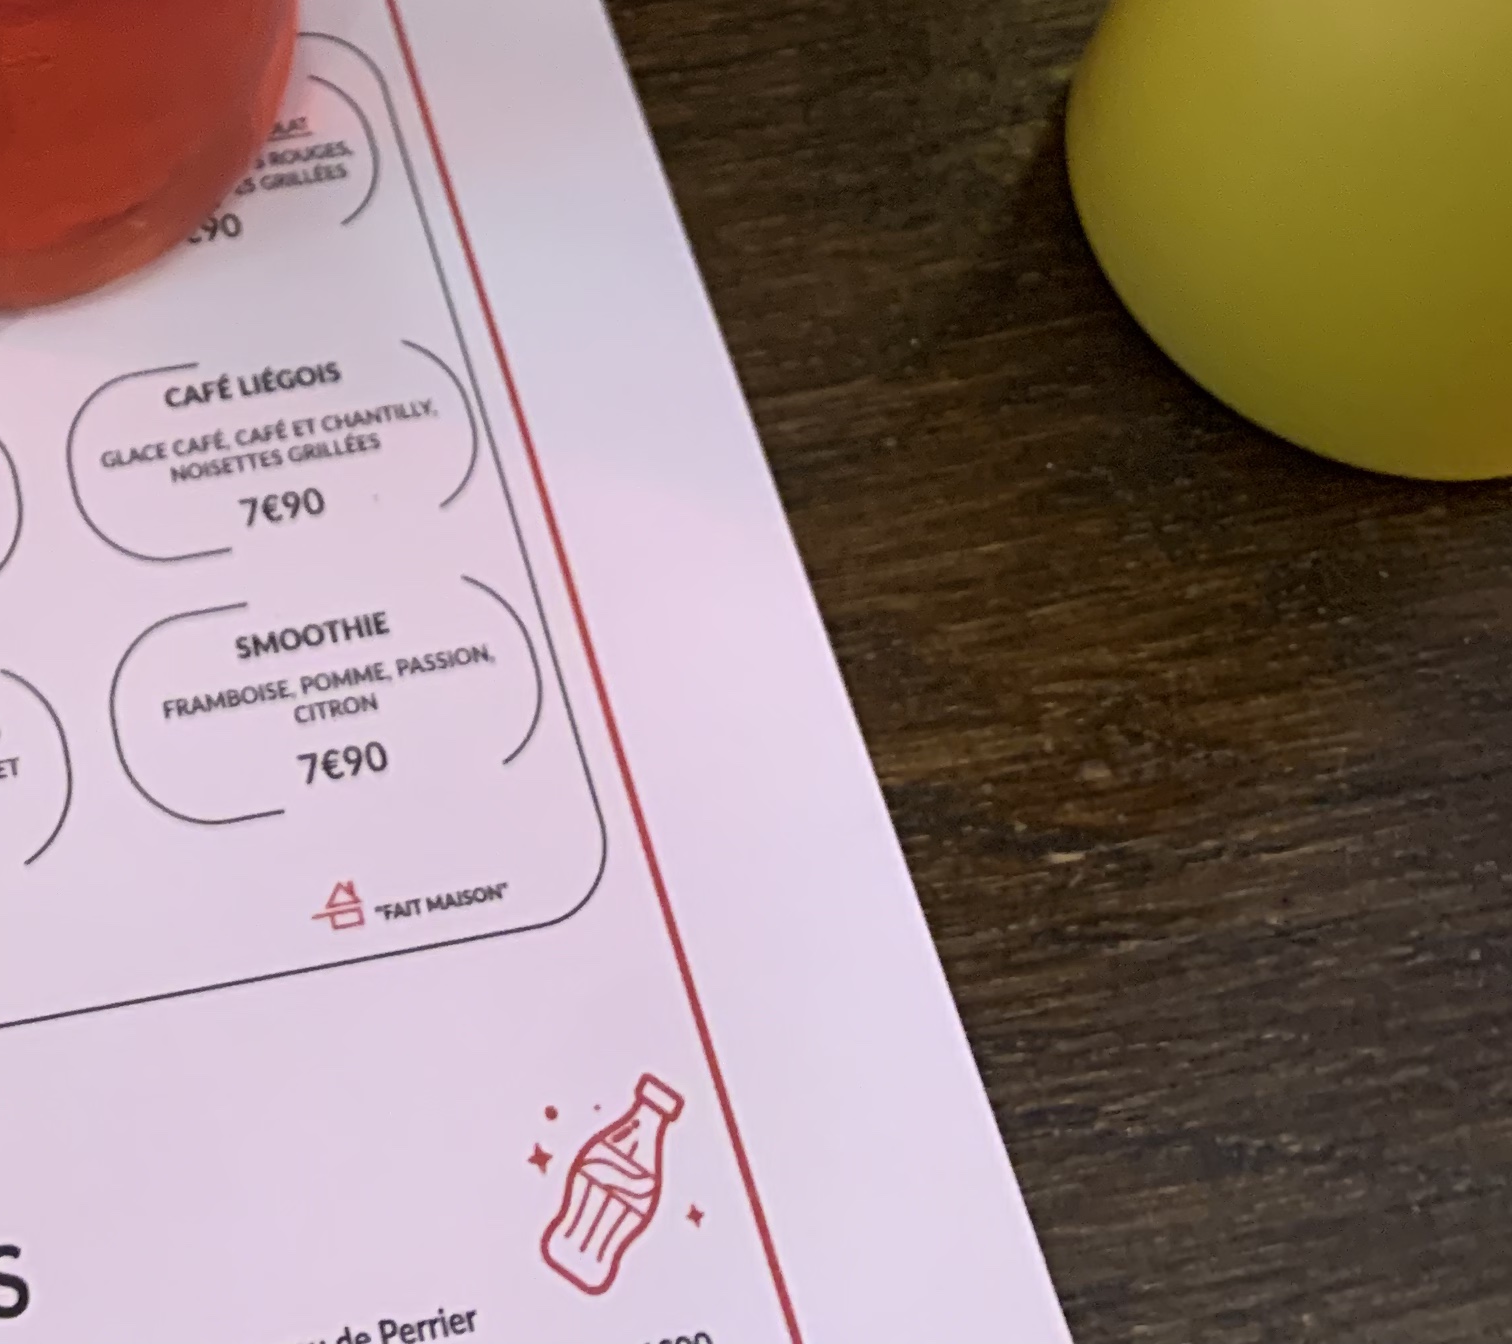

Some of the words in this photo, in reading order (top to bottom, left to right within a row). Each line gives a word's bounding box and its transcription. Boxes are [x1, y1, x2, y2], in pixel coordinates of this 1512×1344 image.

[164, 373, 234, 410] CAFÉ
[237, 360, 342, 398] LIÉGOIS
[100, 441, 168, 469] GLACE
[234, 417, 288, 447] CAFÉ
[292, 417, 316, 438] ET
[170, 449, 284, 483] NOISETTES
[287, 431, 382, 463] GRILLÉES
[238, 487, 326, 527] 7€90
[235, 611, 391, 660] SMOOTHIE
[292, 692, 379, 725] CITRON
[296, 741, 389, 786] 7€90
[377, 1307, 478, 1344] Perrier
